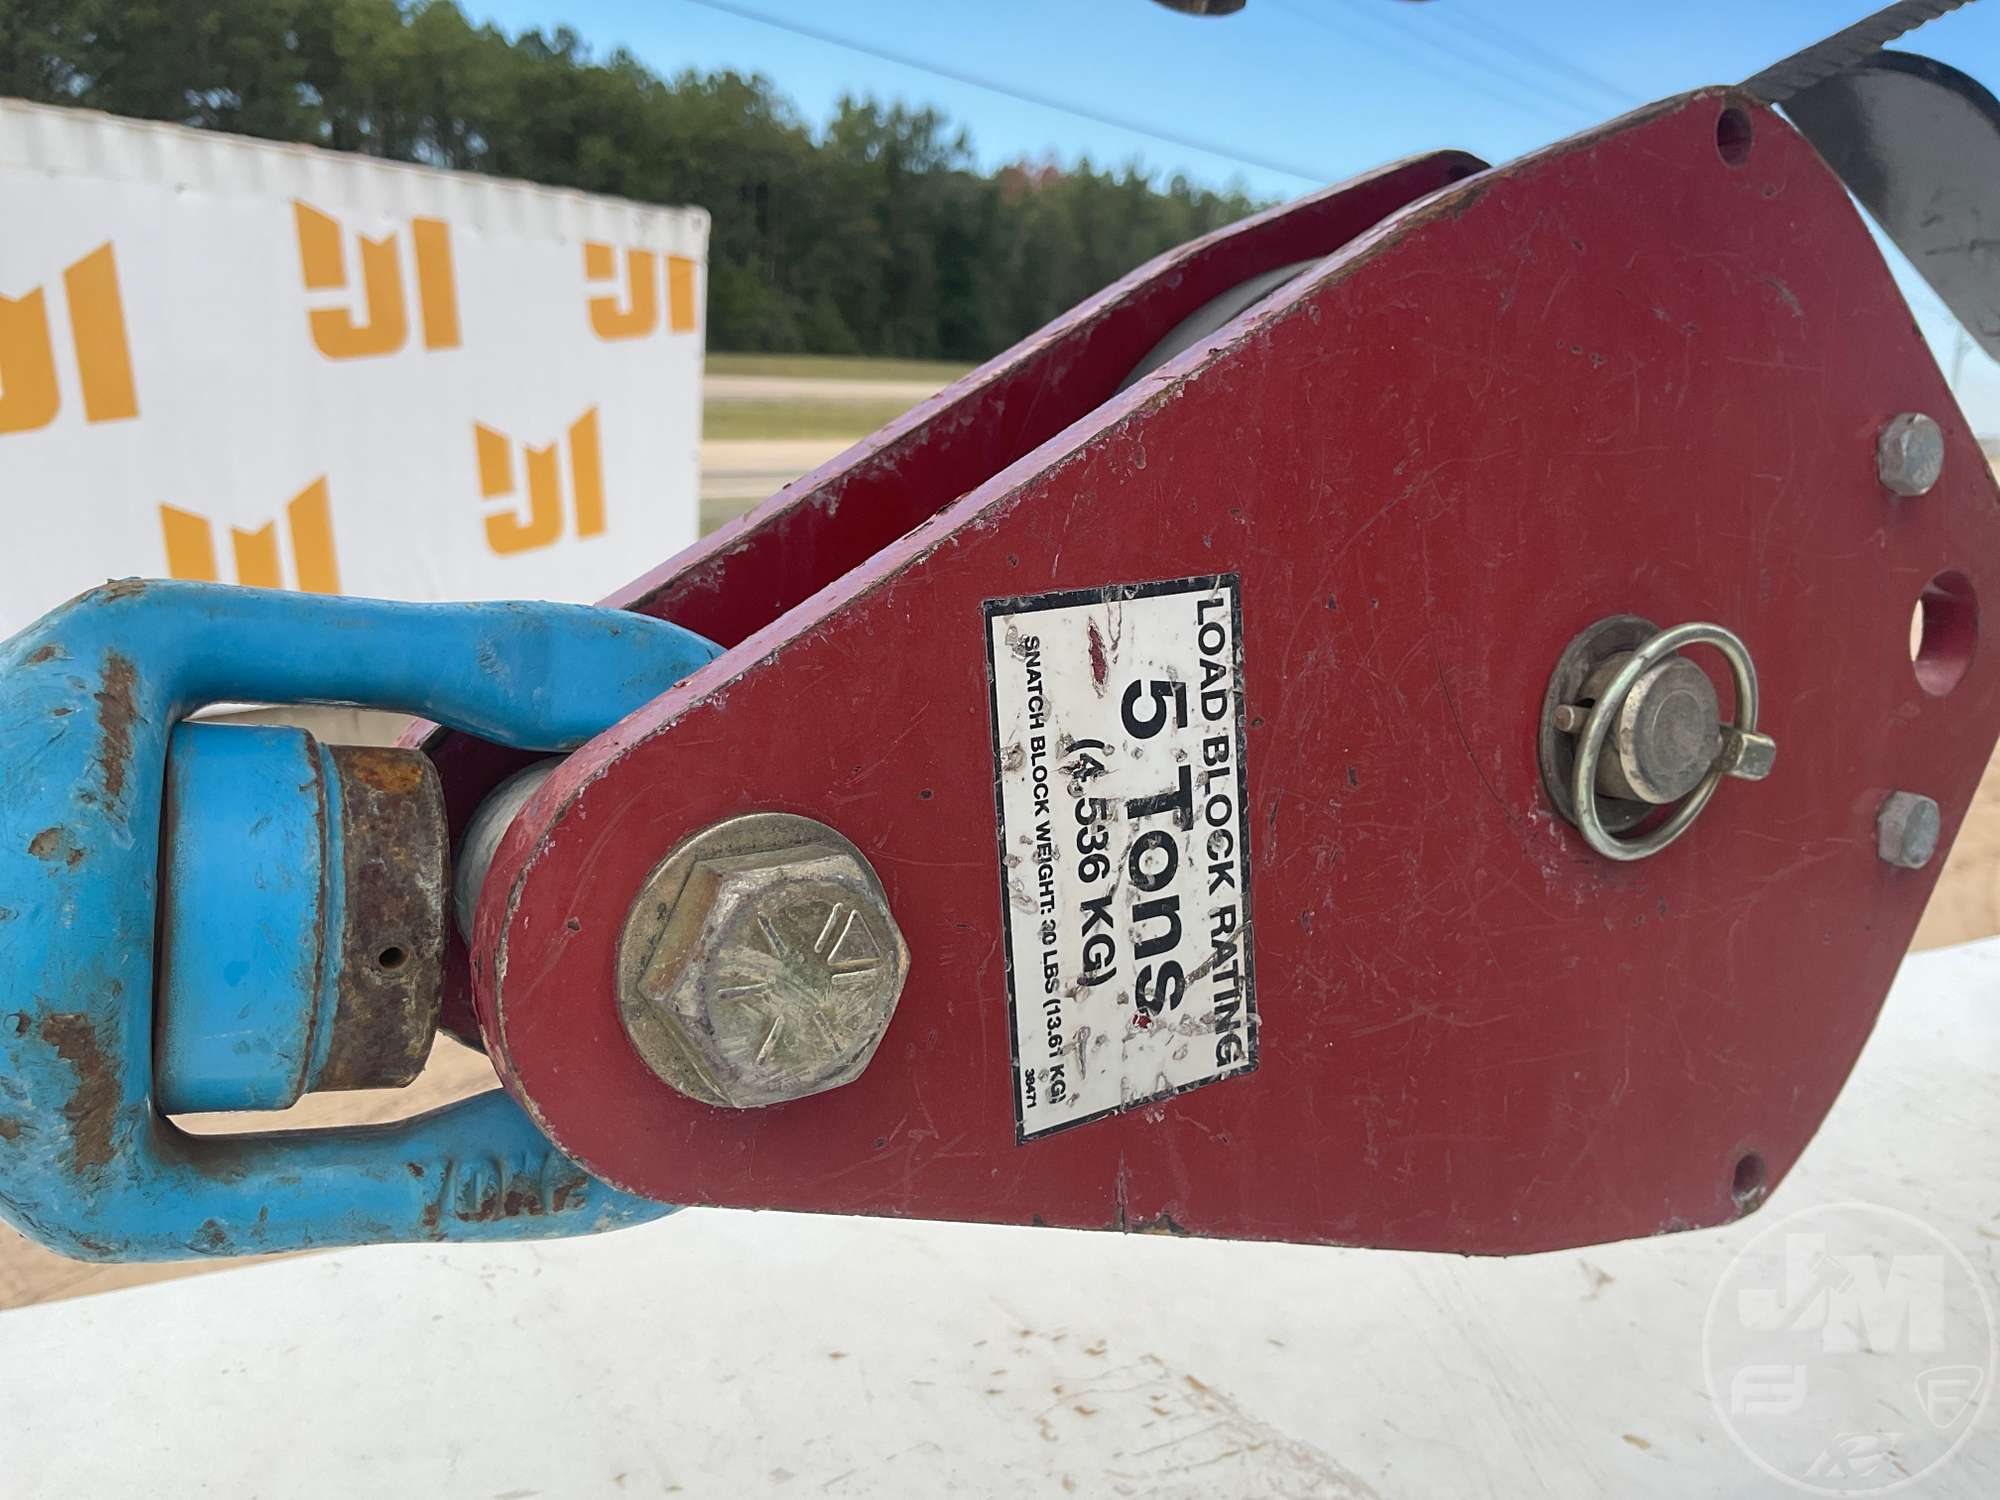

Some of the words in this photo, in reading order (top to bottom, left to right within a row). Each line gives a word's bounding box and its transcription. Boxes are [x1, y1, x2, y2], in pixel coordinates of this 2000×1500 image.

[1024, 635, 1045, 731] SNATCH
[1196, 597, 1228, 721] LOAD
[1121, 679, 1188, 740] 5
[1030, 735, 1050, 818] BLOCK
[1202, 735, 1236, 896] BLOCK
[1035, 819, 1056, 915] WEIGHT:
[1126, 764, 1194, 1016] Tons
[1042, 949, 1060, 995] LBS
[1080, 894, 1118, 987] KG)
[1210, 903, 1243, 1068] RATING
[1042, 998, 1064, 1059] (13.61
[1049, 1063, 1067, 1105] KG)
